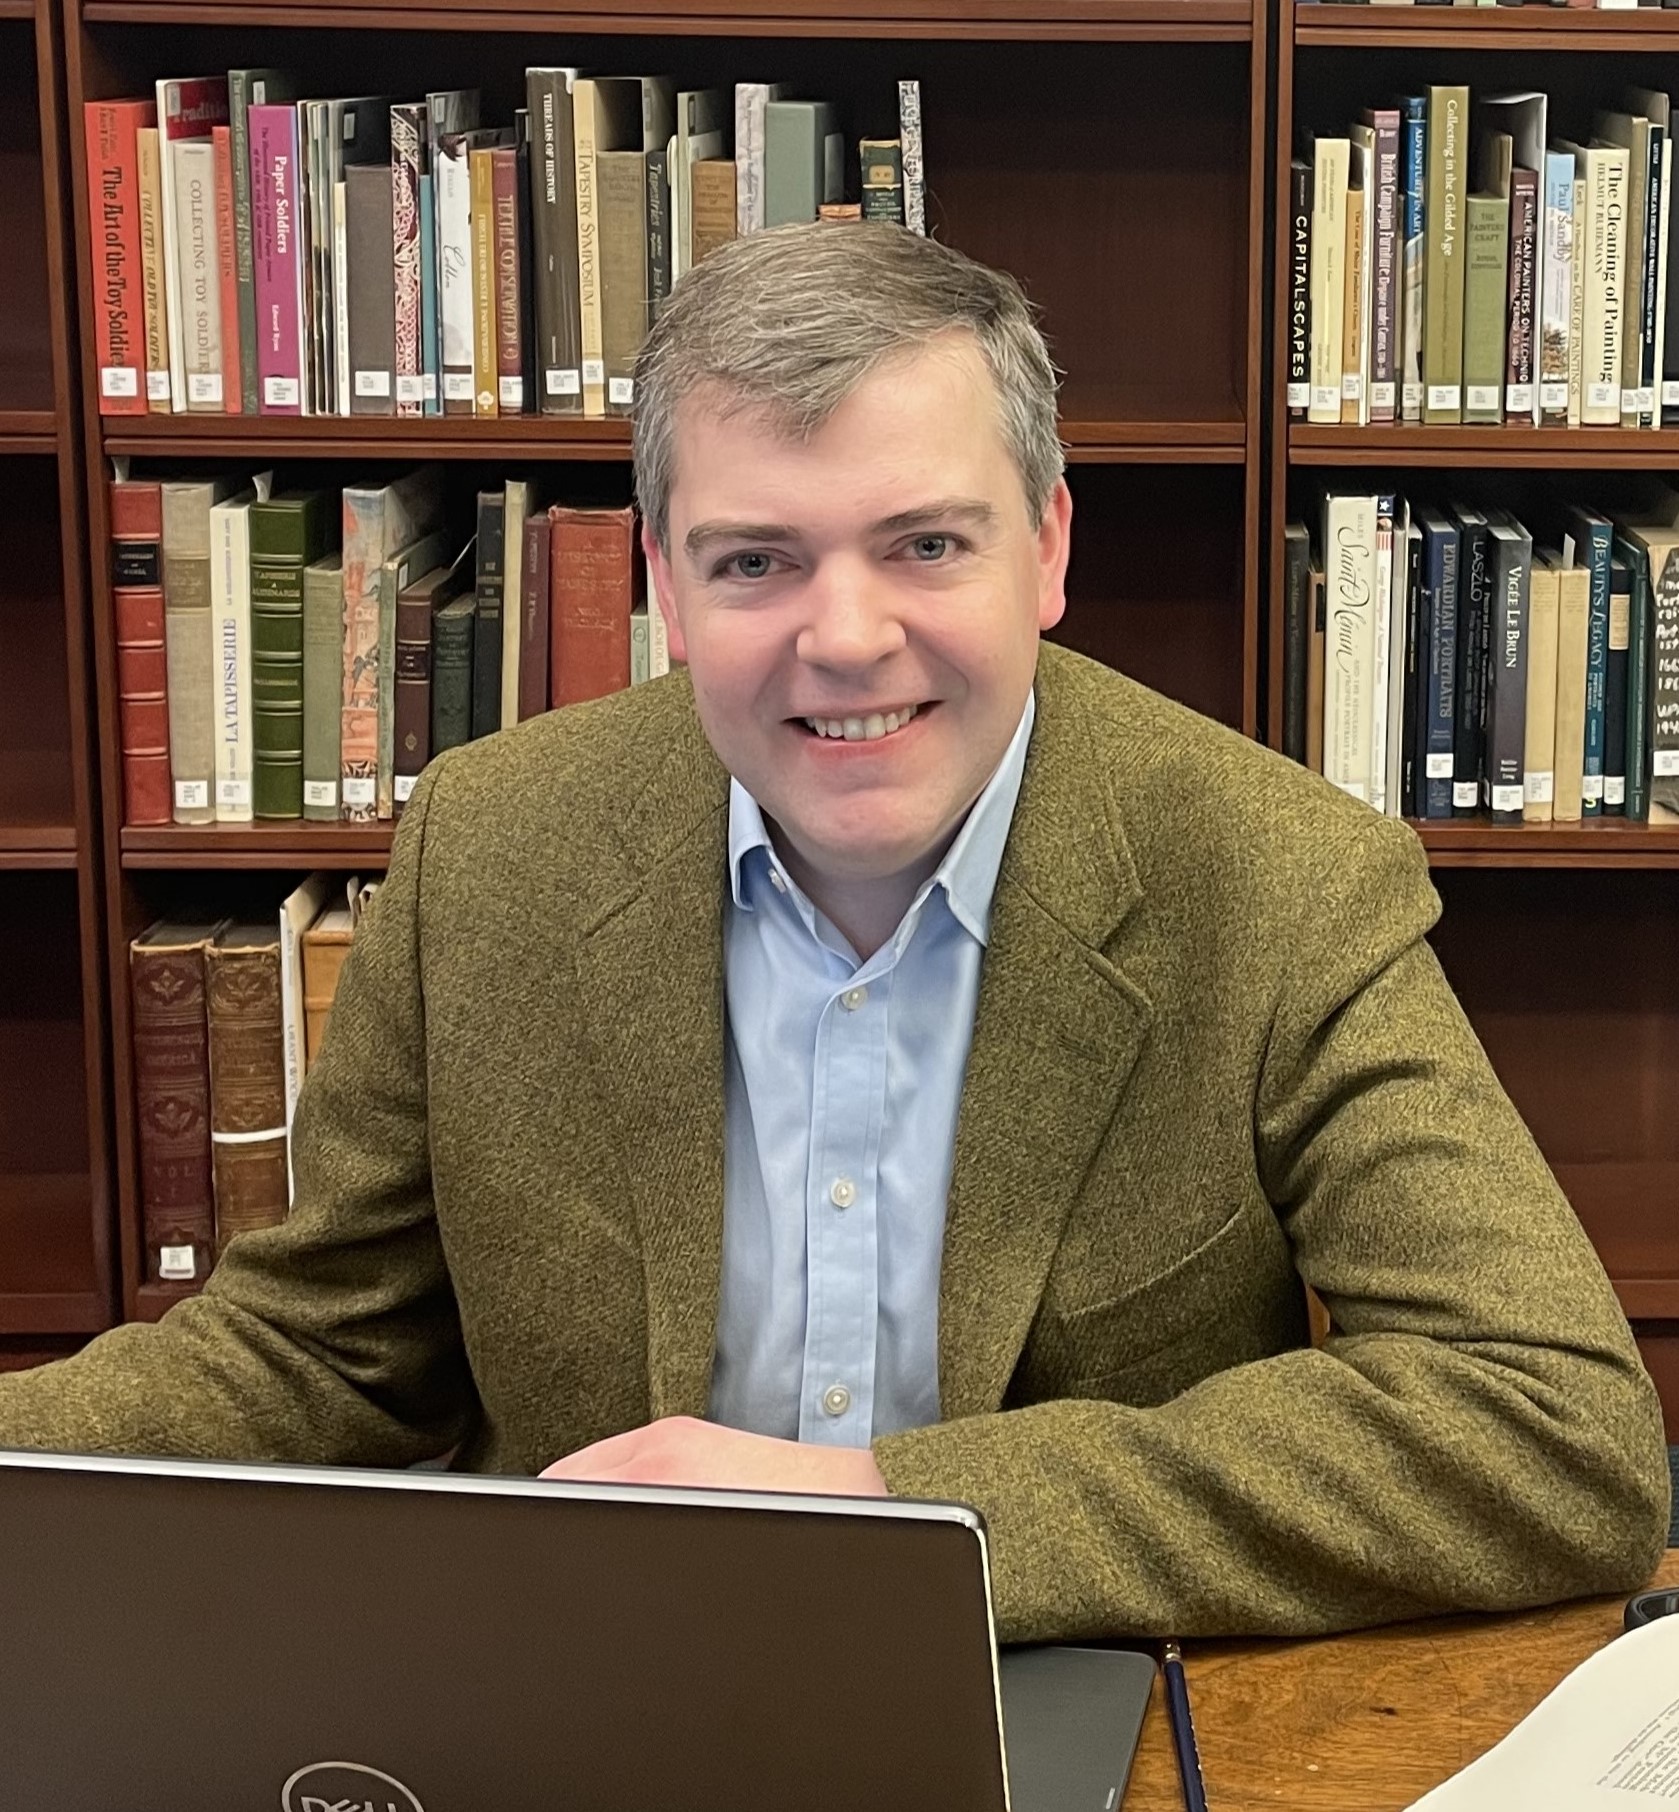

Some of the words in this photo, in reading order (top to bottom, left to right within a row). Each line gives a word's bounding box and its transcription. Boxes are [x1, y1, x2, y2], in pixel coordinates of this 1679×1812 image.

[543, 93, 554, 141] THREADS
[1443, 99, 1457, 157] Collecting
[544, 143, 554, 157] OF
[1380, 153, 1396, 183] British
[1445, 159, 1456, 171] in
[101, 166, 122, 199] The
[272, 155, 288, 194] Paper
[545, 159, 556, 204] HISTORY
[577, 151, 594, 216] TAPESTRY
[1445, 173, 1456, 192] the
[1595, 162, 1605, 209] HELMUT
[1607, 162, 1623, 198] The
[649, 163, 663, 226] Tapestries
[1377, 184, 1395, 230] Campaign
[1444, 193, 1456, 232] Gilded
[1557, 183, 1571, 212] Paul
[1575, 184, 1584, 206] Keck
[1650, 177, 1658, 214] AMERICAN
[104, 202, 124, 231] Art
[190, 179, 206, 269] COLLECTING
[275, 198, 290, 254] Soldiers
[497, 194, 515, 248] TEXTILE
[1413, 213, 1422, 234] ART
[1481, 213, 1495, 221] THE
[1521, 202, 1533, 257] AMERICAN
[1649, 214, 1657, 258] DECORATIVE
[105, 231, 126, 248] of
[1441, 234, 1454, 257] Age
[1514, 239, 1522, 255] THE
[1552, 216, 1572, 263] Sandby
[1594, 212, 1605, 274] RUHEMANN
[1601, 203, 1622, 282] Cleaning
[106, 250, 125, 277] the
[581, 222, 596, 307] SYMPOSIUM
[1513, 258, 1522, 298] COLONIAL
[103, 277, 128, 309] Toy
[194, 277, 207, 303] TOY
[499, 249, 518, 344] CONSERVATION
[1292, 215, 1308, 377] CAPITALSCAPES
[1521, 261, 1532, 314] PAINTERS
[1572, 285, 1583, 316] CARE
[1604, 287, 1619, 304] of
[271, 304, 281, 331] Edward
[1512, 301, 1521, 331] PERIOD
[1521, 317, 1531, 334] ON
[1571, 317, 1582, 332] OF
[1570, 336, 1581, 395] PAINTINGS
[1442, 543, 1456, 630] EDWARDIAN
[1469, 540, 1484, 602] LASZLO
[1507, 565, 1522, 607] VIGÉE
[1591, 536, 1609, 607] BEAUTY'S
[1506, 609, 1522, 626] LE
[1505, 629, 1520, 668] BRUN
[1590, 608, 1607, 669] LEGACY
[223, 618, 238, 718] TAPISSERIE
[1439, 637, 1455, 718] PORTRAITS
[1656, 703, 1679, 718] WP
[225, 720, 238, 744] LA
